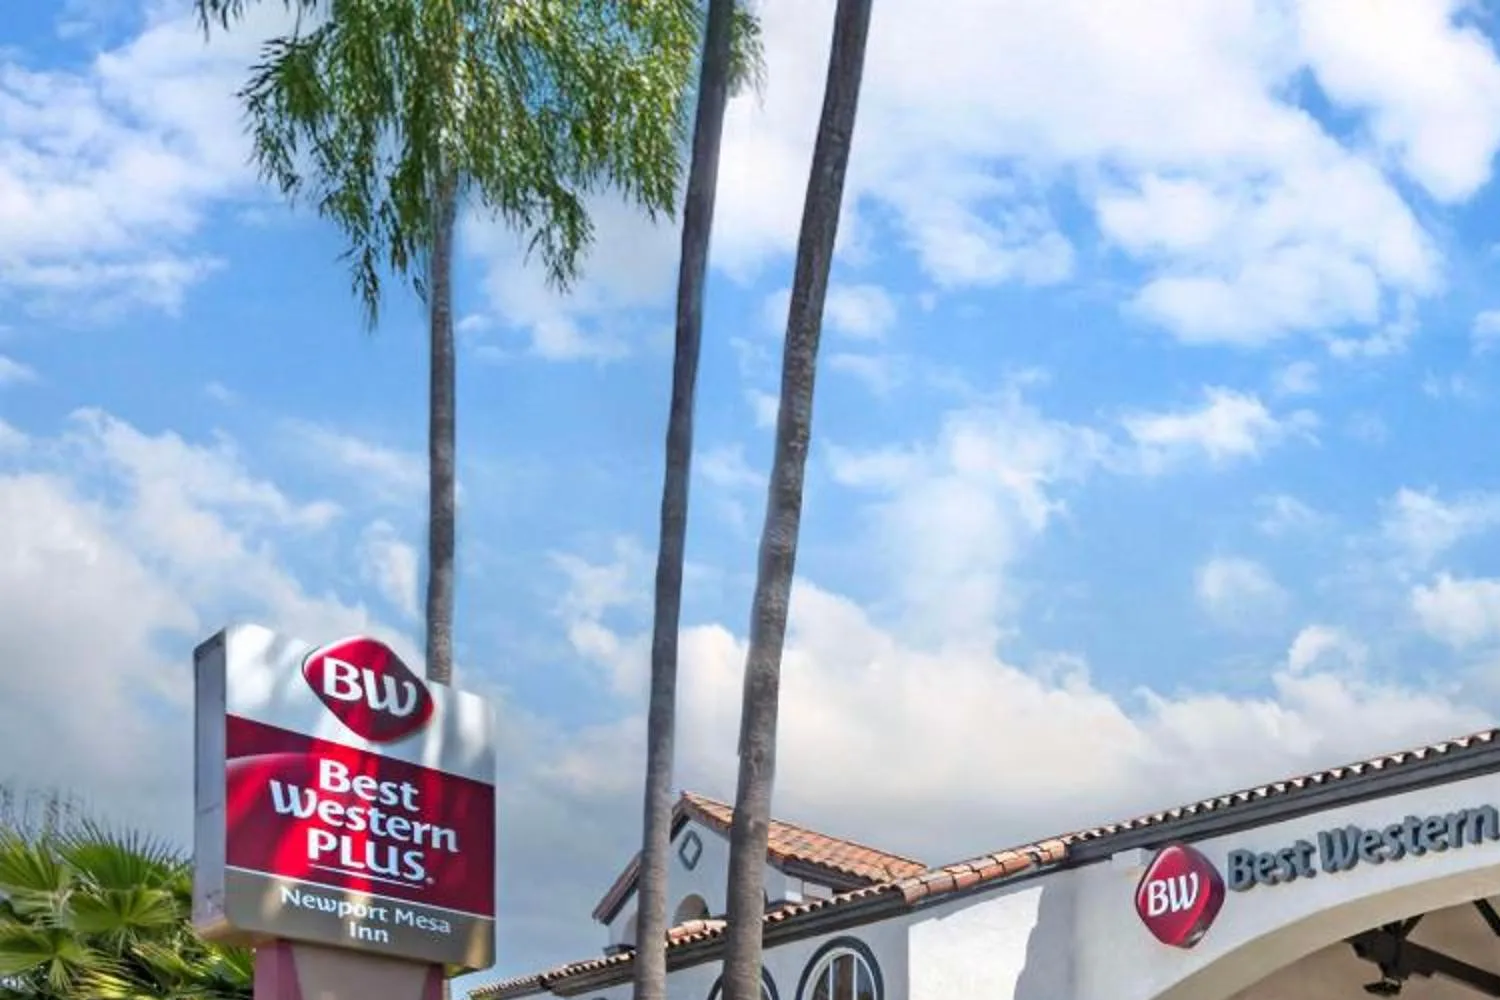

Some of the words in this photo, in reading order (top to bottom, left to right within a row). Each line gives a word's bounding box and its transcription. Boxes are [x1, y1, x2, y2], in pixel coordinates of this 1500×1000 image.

[322, 656, 418, 717] BW
[319, 759, 420, 812] Best
[269, 779, 458, 853] Western
[306, 828, 426, 882] PLUS
[1227, 840, 1316, 892] Best
[280, 886, 388, 922] Newport
[395, 908, 451, 934] Mesa
[1147, 872, 1200, 917] BW
[349, 922, 389, 944] Inn
